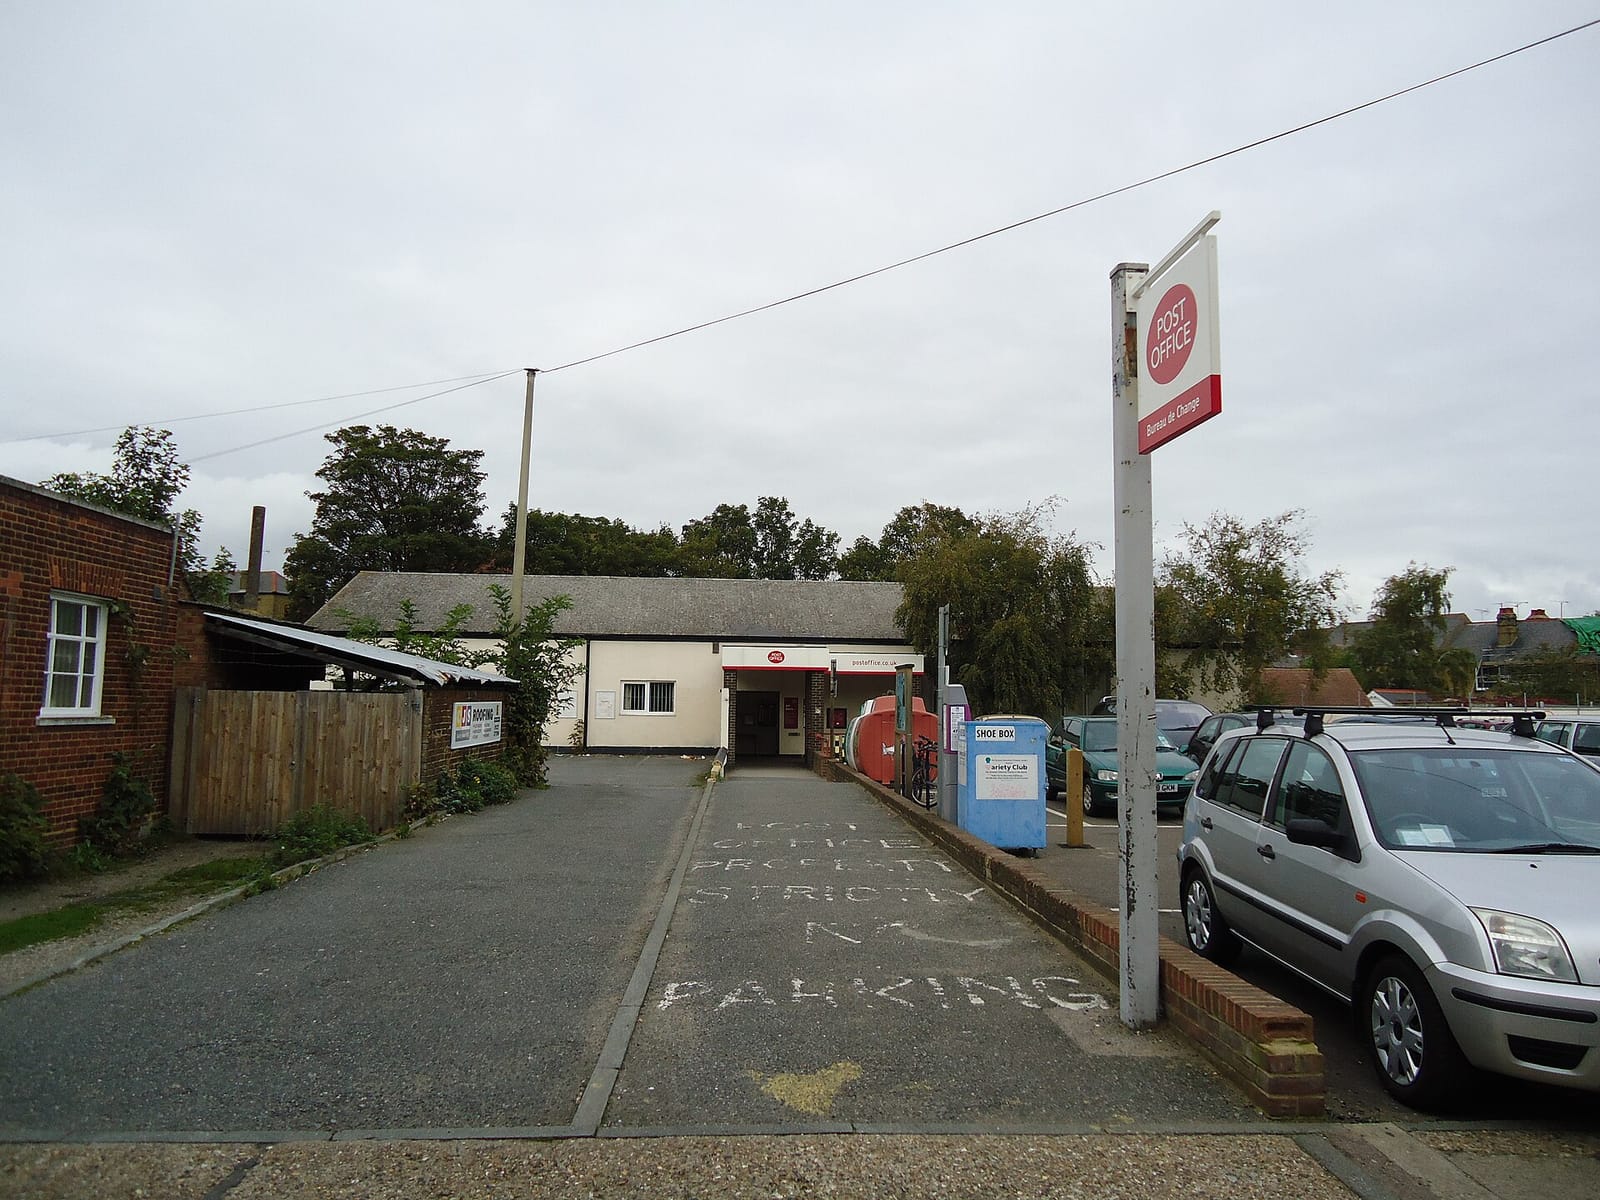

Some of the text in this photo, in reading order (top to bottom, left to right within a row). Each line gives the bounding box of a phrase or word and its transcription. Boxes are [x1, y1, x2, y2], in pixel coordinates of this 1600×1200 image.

[1157, 297, 1186, 340] POST
[1151, 320, 1191, 369] OFFICE
[1146, 397, 1200, 437] Bureau de Change
[473, 708, 494, 722] ROOFING
[976, 729, 1015, 738] SHOE BOX
[1012, 763, 1028, 771] Club
[712, 837, 921, 850] OFFICE
[687, 885, 986, 905] STRICTLY
[656, 975, 1109, 1011] PARKING
